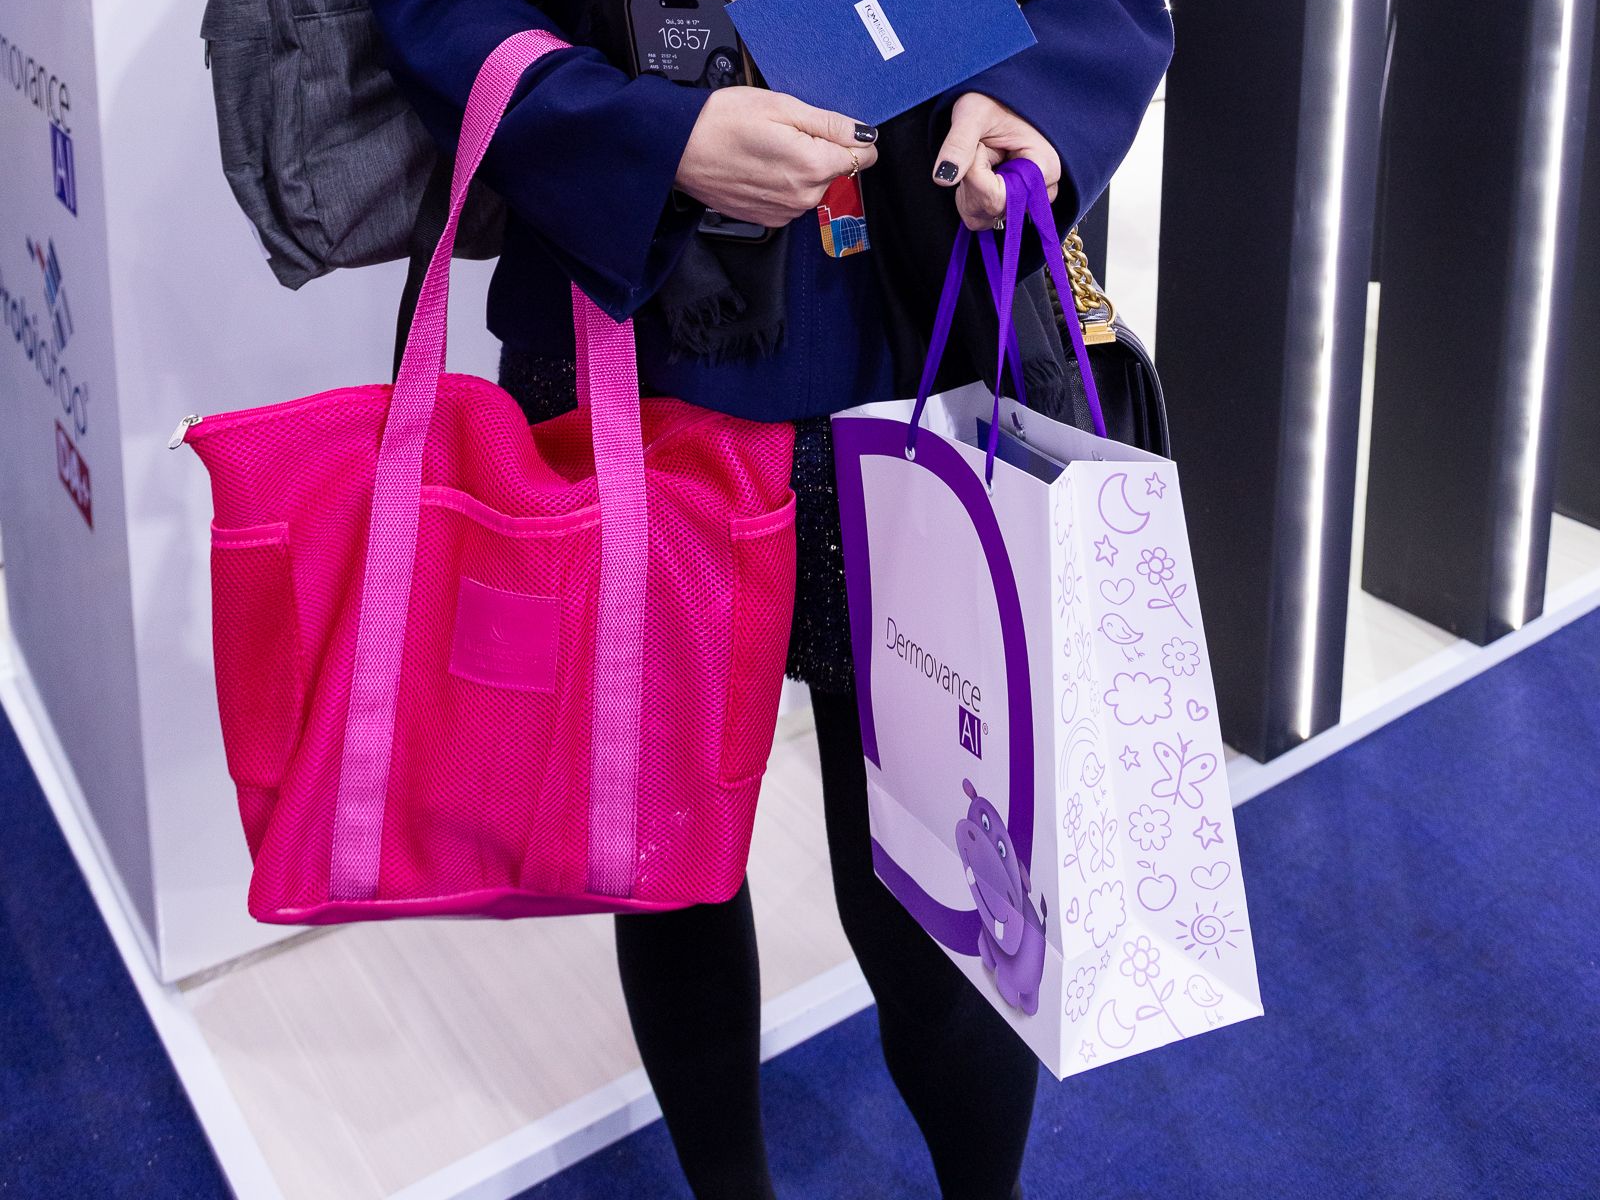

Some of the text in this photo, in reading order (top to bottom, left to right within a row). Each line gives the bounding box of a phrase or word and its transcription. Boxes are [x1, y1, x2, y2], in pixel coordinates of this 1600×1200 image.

[864, 4, 879, 24] FQM
[658, 27, 711, 50] 16:57
[886, 616, 982, 713] Dermovance
